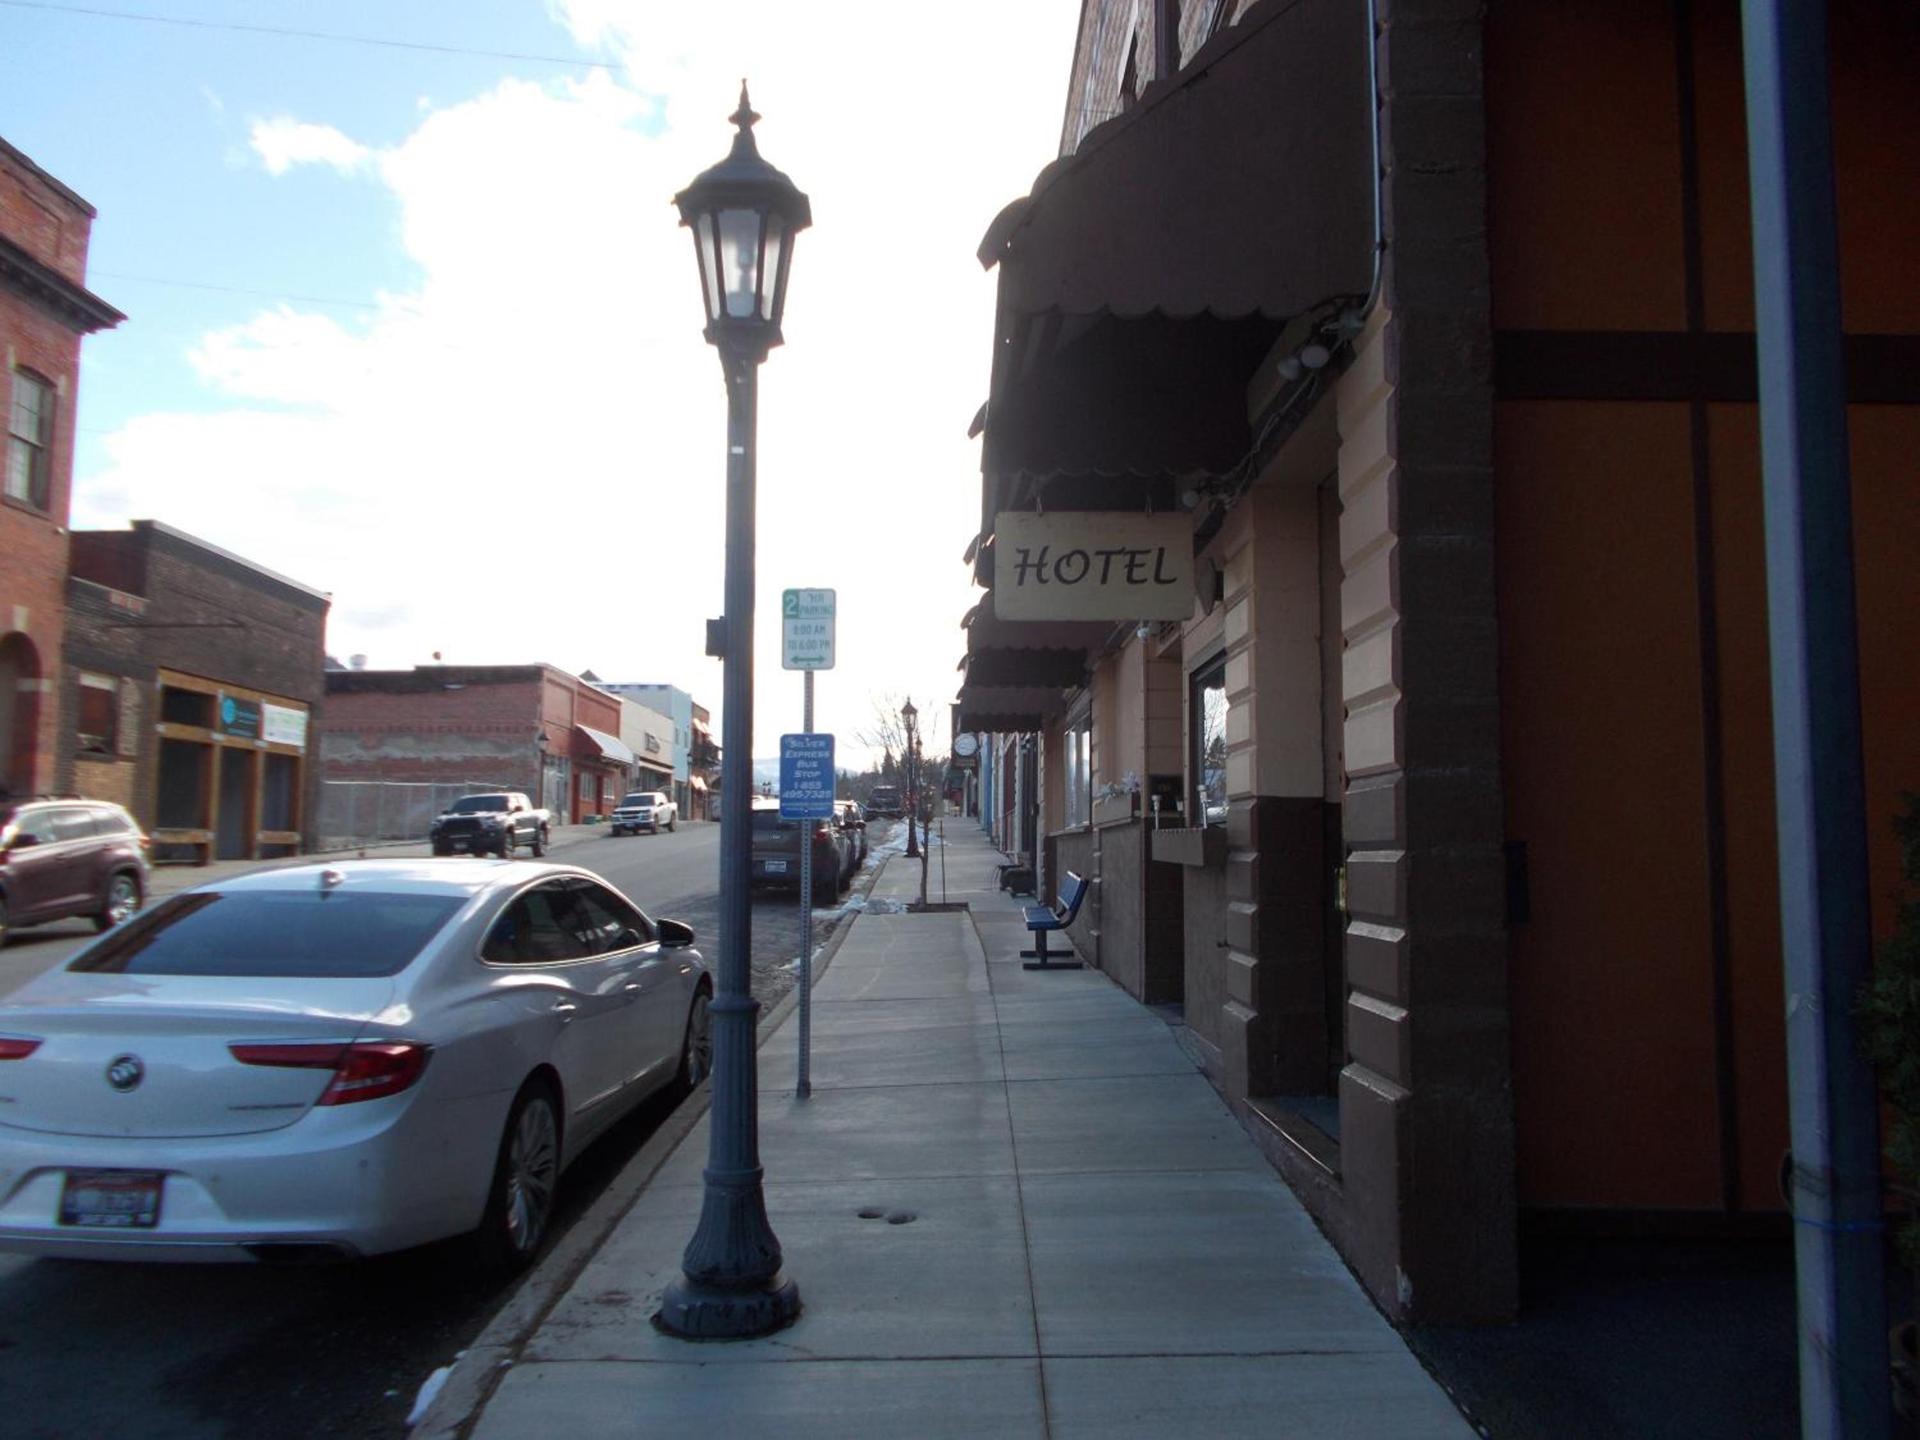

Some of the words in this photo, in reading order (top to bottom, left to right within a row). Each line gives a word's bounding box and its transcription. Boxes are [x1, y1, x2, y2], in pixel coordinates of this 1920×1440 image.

[1014, 546, 1177, 585] HOTEL
[785, 594, 798, 615] 2
[814, 624, 826, 635] AM
[794, 770, 821, 778] STOP
